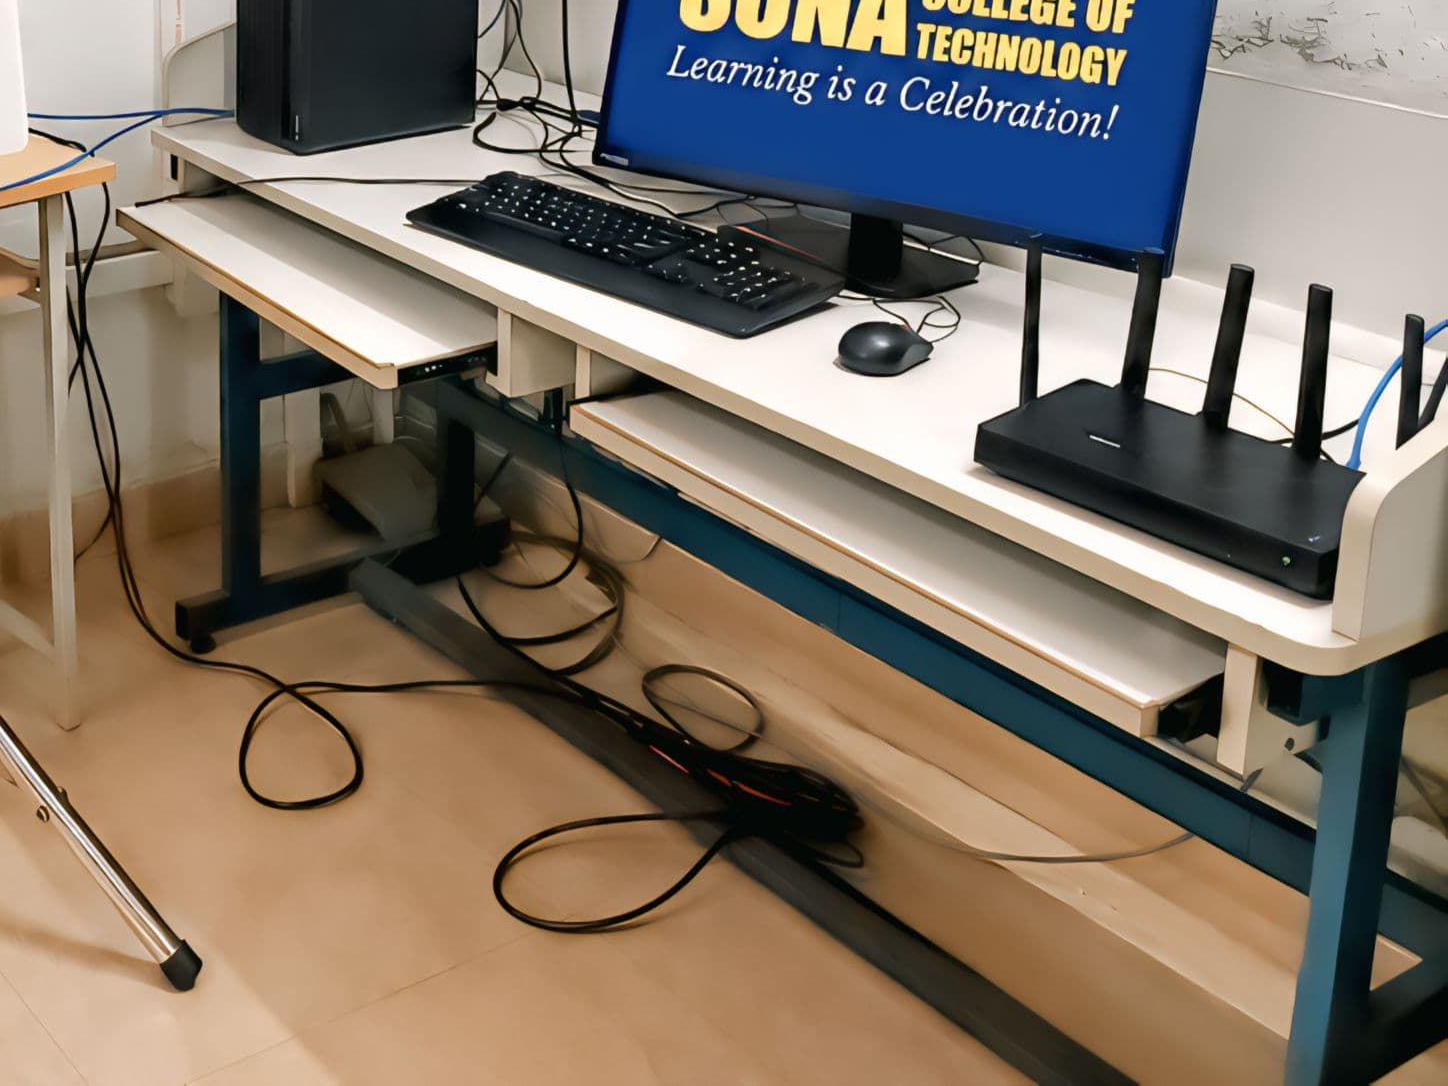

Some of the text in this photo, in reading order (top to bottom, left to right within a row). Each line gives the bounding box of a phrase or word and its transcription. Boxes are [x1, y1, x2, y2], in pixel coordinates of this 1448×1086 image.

[667, 45, 1120, 140] Learning is a Celebration!
[916, 22, 1128, 86] TECHNOLOGY
